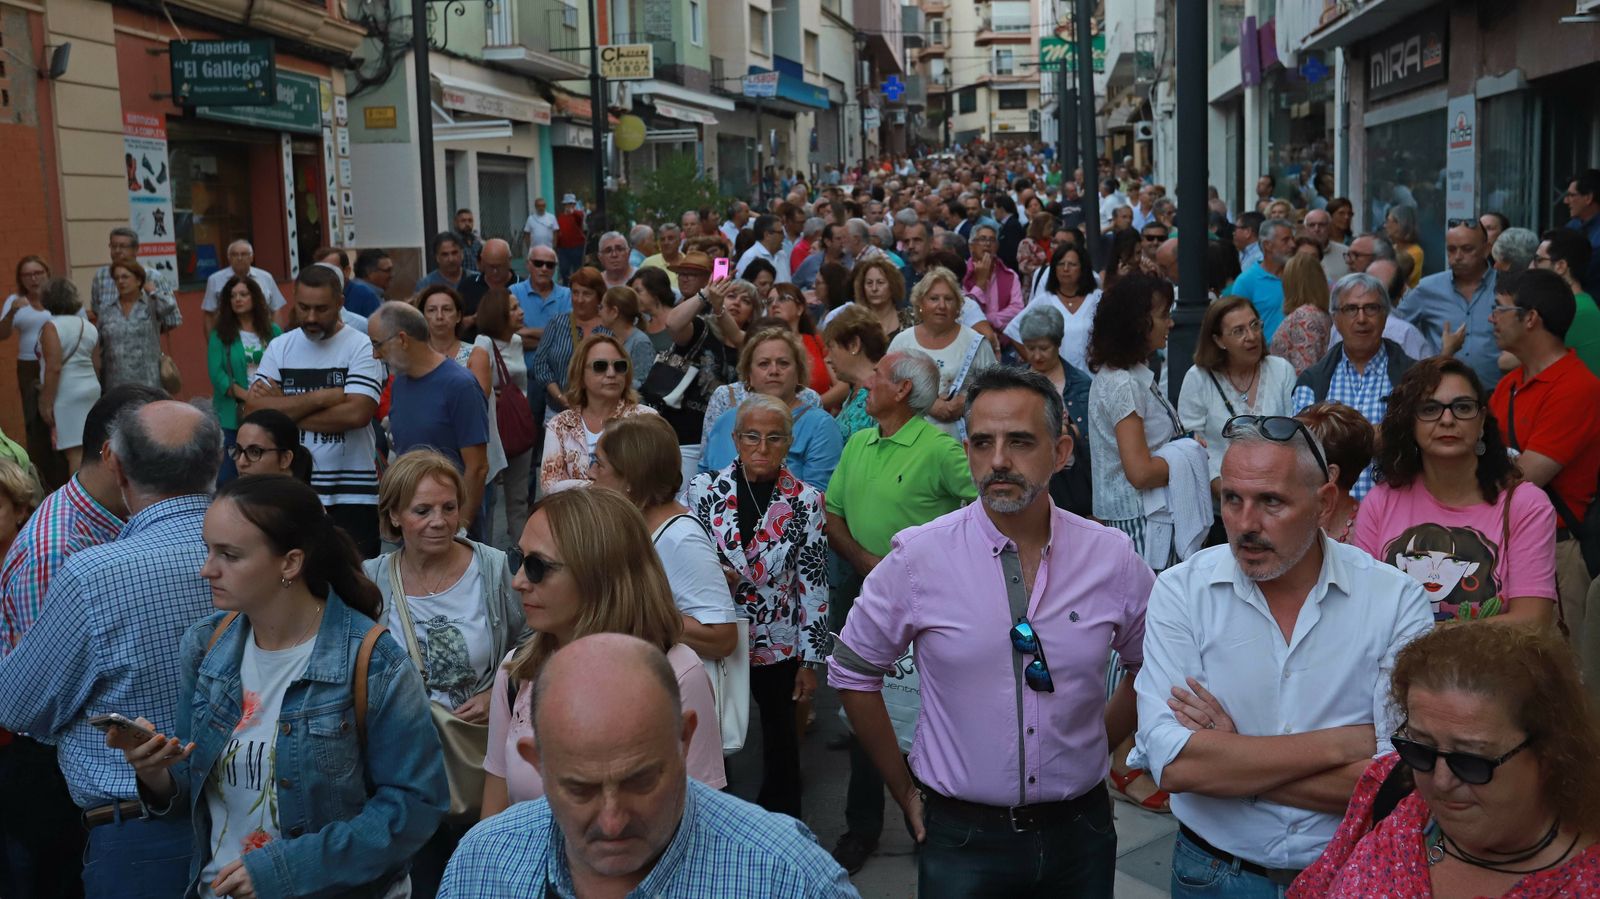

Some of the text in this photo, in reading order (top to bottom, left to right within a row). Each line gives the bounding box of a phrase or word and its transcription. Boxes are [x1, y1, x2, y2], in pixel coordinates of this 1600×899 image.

[191, 41, 251, 56] Zapatería
[883, 682, 921, 696] uentro
[226, 738, 268, 791] OM
